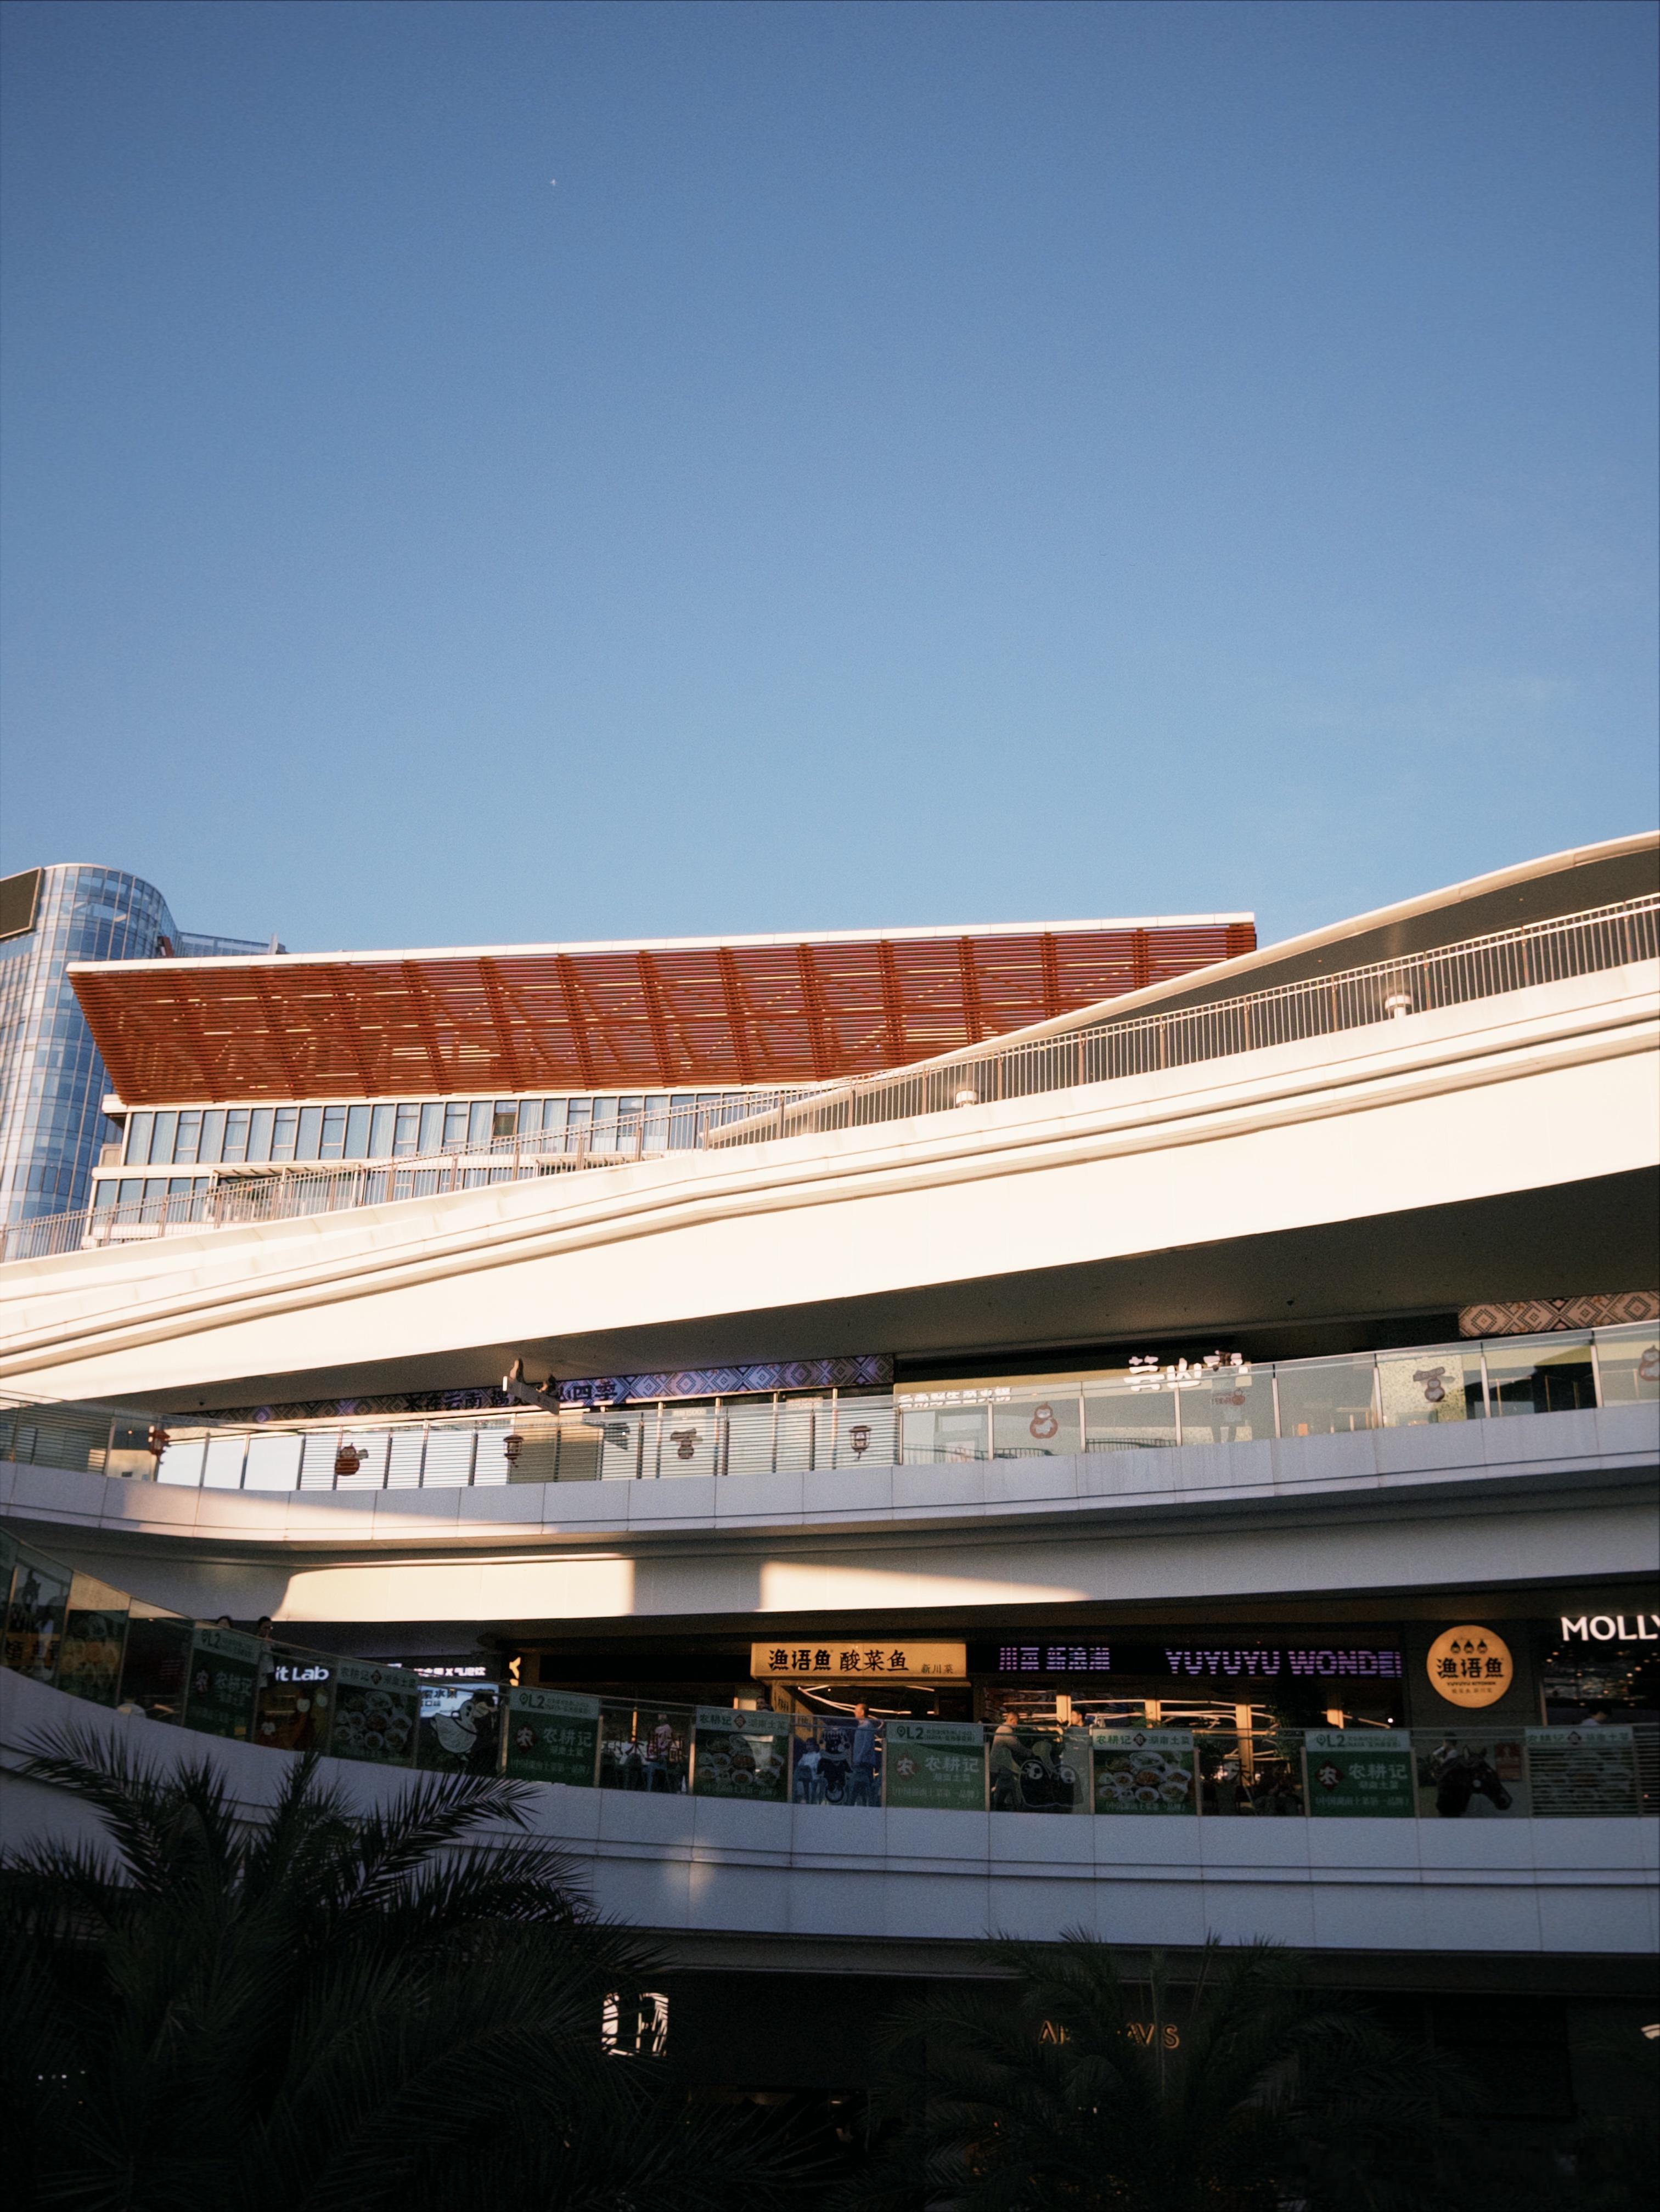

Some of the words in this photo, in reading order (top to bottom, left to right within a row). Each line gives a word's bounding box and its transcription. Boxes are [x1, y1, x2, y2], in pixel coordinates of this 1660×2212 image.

[840, 1649, 909, 1672] 酸菜鱼
[1164, 1648, 1281, 1675] YUYUYU
[291, 1664, 329, 1681] Lab
[907, 1726, 924, 1740] L2
[1327, 1735, 1344, 1747] L2
[925, 1756, 980, 1773] 农耕记
[1349, 1763, 1408, 1780] 农耕记
